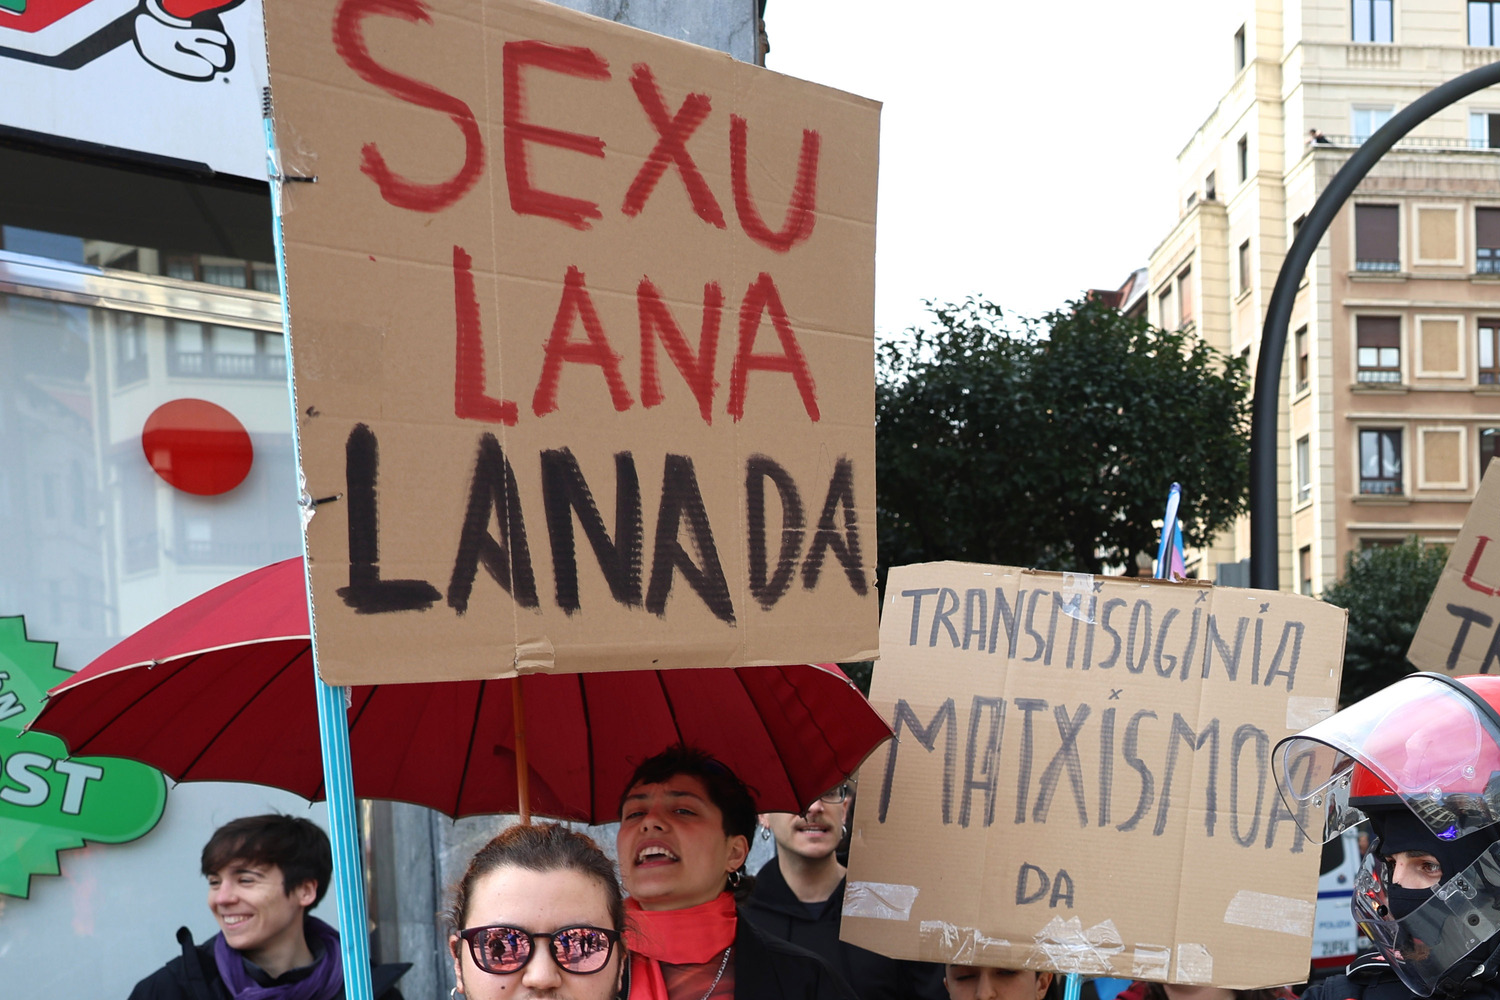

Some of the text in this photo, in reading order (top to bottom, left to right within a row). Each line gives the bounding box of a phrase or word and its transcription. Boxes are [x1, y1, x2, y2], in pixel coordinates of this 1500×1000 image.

[333, 0, 821, 252] SEXU
[453, 245, 821, 425] LANA
[0, 751, 105, 816] ST
[1015, 862, 1075, 909] DA
